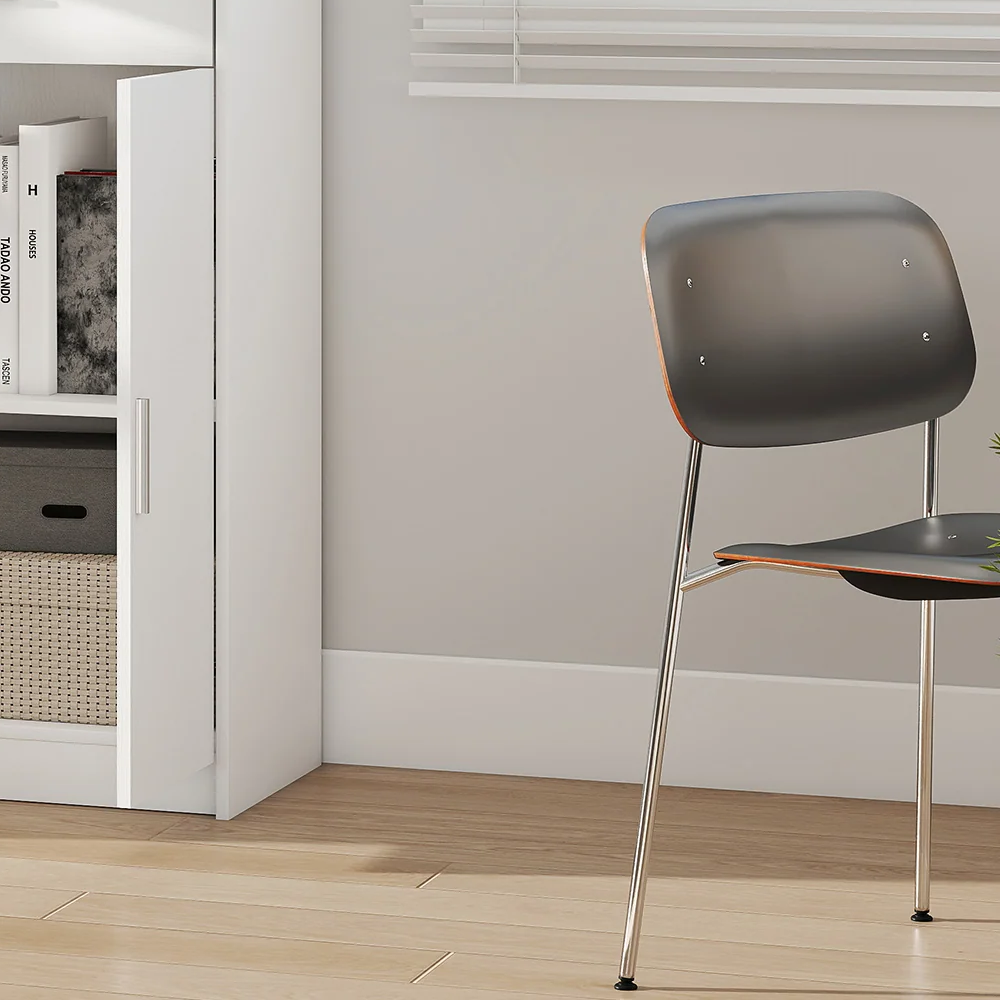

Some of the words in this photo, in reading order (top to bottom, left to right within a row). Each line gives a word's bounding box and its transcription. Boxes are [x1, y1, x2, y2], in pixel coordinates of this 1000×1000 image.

[0, 237, 11, 272] TADAO
[28, 229, 37, 259] HOUSES
[0, 274, 11, 304] ANDO
[1, 358, 11, 386] TASCEN
